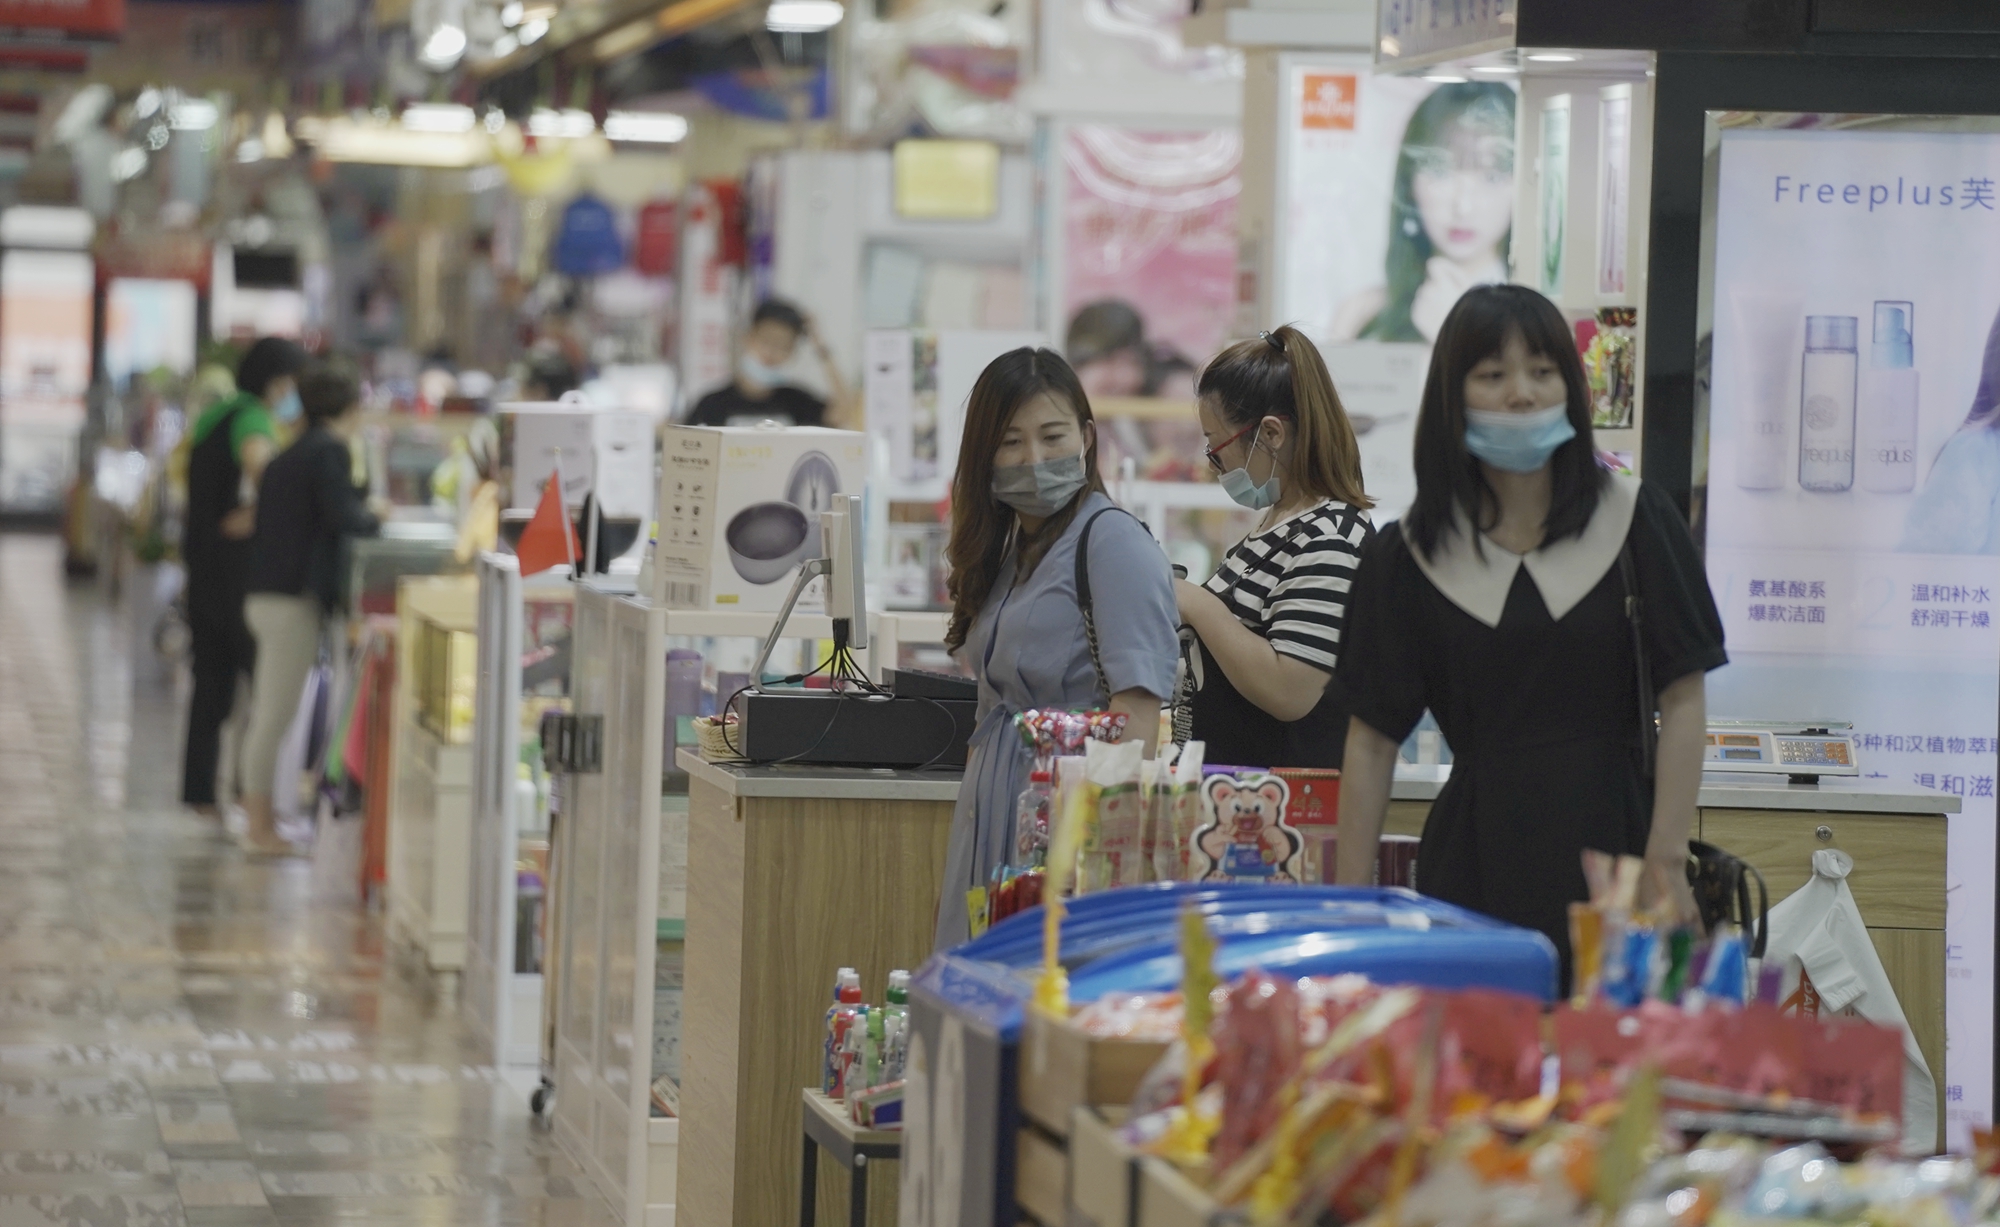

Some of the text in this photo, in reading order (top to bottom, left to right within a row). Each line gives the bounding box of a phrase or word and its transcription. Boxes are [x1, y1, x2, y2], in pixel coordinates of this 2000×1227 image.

[1748, 579, 1826, 600] 氨基酸系
[1911, 584, 1991, 604] 温和补水
[1748, 604, 1826, 624] 爆款洁面
[1911, 609, 1991, 629] 舒润干燥
